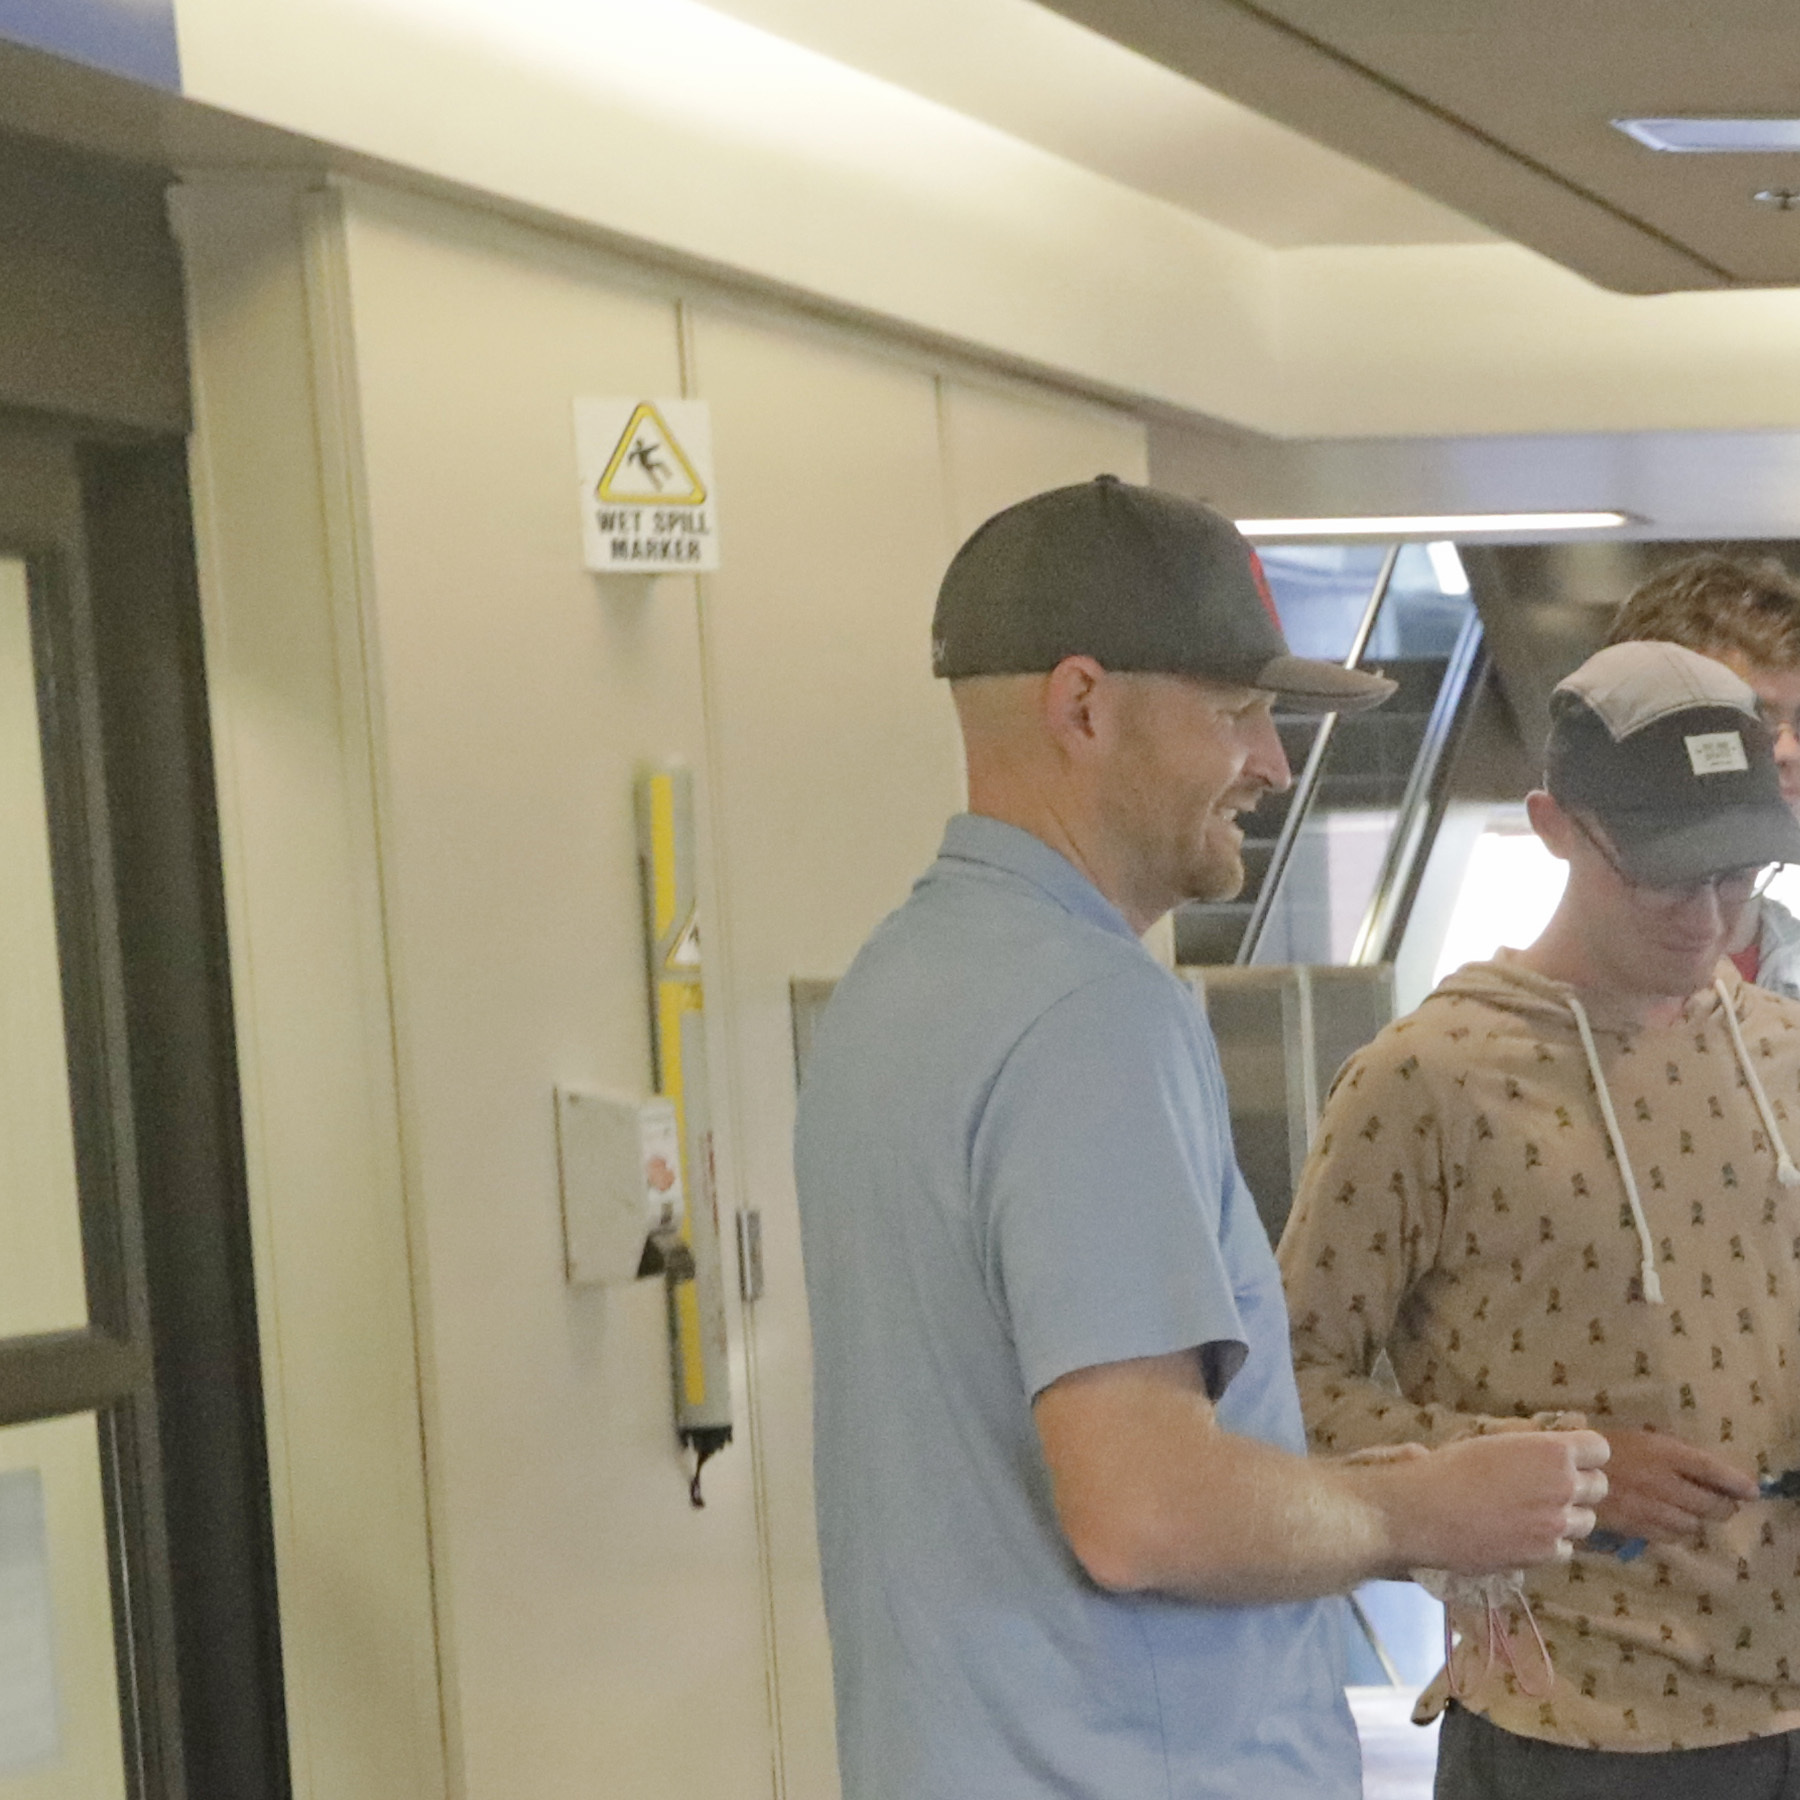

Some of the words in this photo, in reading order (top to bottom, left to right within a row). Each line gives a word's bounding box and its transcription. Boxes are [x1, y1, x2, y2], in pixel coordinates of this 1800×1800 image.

[596, 510, 642, 533] WET
[653, 511, 710, 535] SPILL
[611, 538, 702, 562] MARKER
